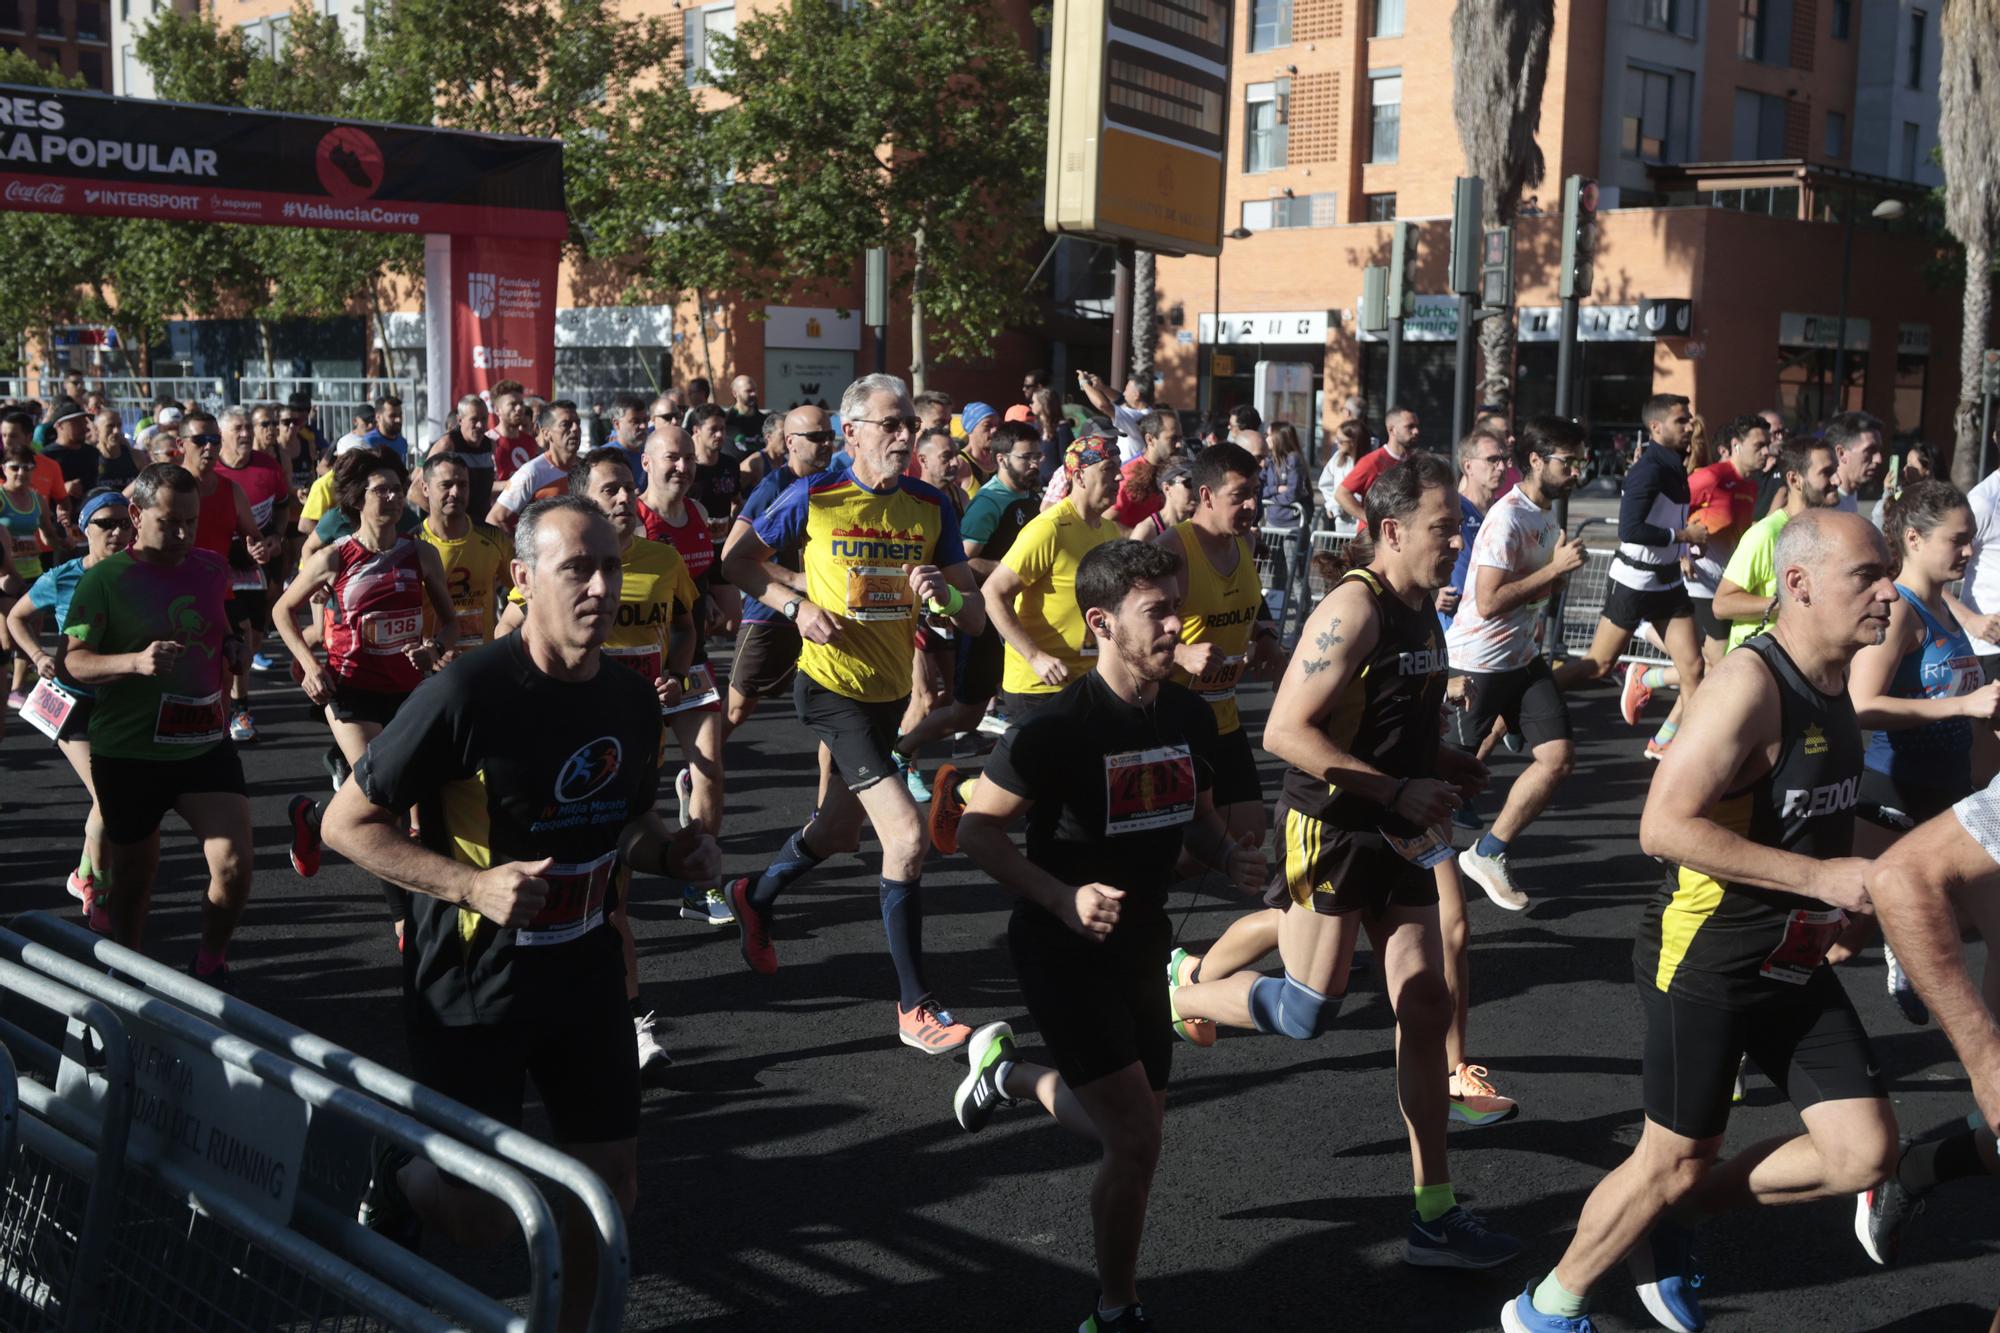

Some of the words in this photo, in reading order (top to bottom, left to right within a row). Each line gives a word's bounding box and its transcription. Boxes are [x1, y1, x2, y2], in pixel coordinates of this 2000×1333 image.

[40, 134, 219, 177] POPULAR
[101, 190, 200, 211] INTERSPORT
[281, 201, 420, 226] #ValènciaCorre
[1403, 318, 1458, 335] unning
[832, 539, 923, 561] runners
[384, 618, 416, 635] 136
[206, 1127, 287, 1199] RUNNING
